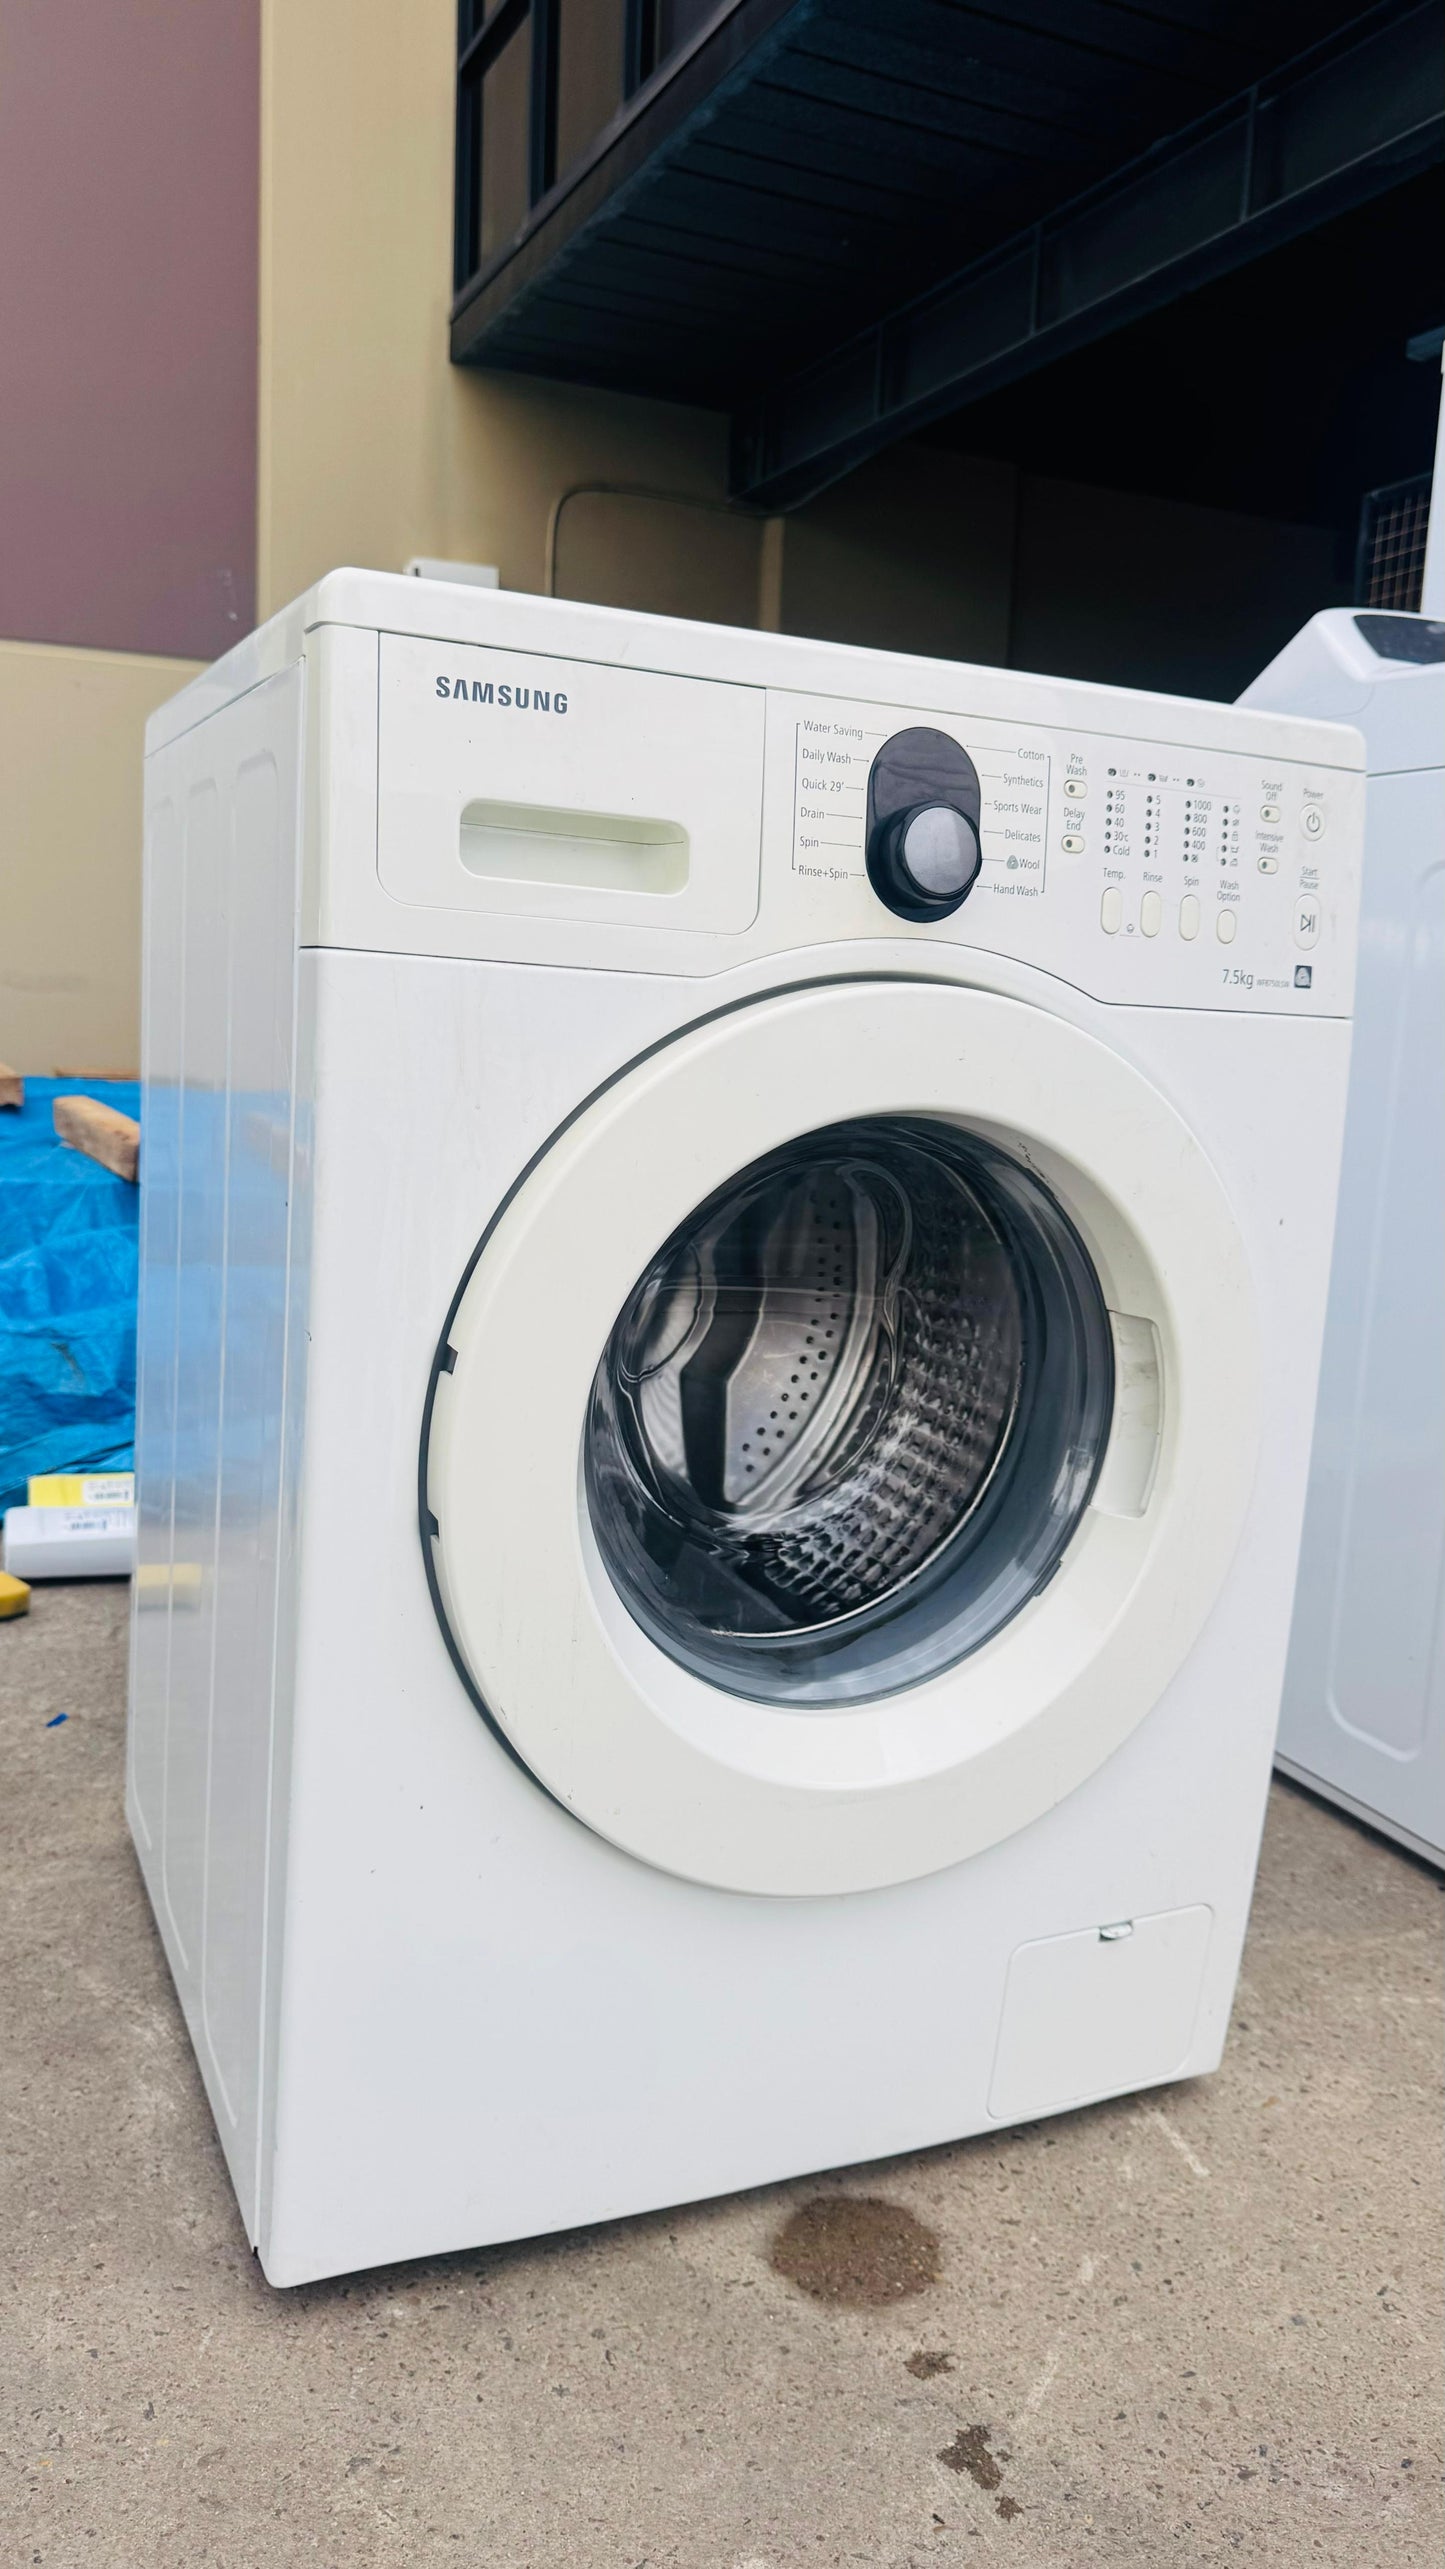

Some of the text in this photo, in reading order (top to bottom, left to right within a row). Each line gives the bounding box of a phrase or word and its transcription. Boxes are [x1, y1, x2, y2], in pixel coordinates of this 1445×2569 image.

[435, 676, 568, 714] SAMSUNG
[803, 720, 863, 740] Water Saving
[802, 748, 852, 764] Daily Wash
[1017, 748, 1045, 761] Cotton
[1070, 753, 1083, 764] Pre
[1066, 764, 1088, 776] Wash
[801, 778, 827, 791] Quick
[1003, 773, 1044, 788] Synthetics
[1261, 780, 1283, 792] Sound
[1115, 790, 1125, 800] 95
[1156, 795, 1161, 805] 5
[1265, 791, 1277, 801] Off
[1303, 788, 1324, 800] Power
[993, 800, 1042, 815] Sports Wear
[1114, 803, 1125, 814] 60
[1193, 799, 1212, 811] 1000
[800, 806, 825, 819] Drain
[1063, 807, 1085, 820] Delay
[1154, 808, 1160, 818] 4
[1193, 813, 1208, 824] 800
[1066, 820, 1081, 831] End
[1114, 817, 1124, 828] 40
[1155, 822, 1160, 832] 3
[1004, 829, 1041, 843] Delicates
[1192, 826, 1206, 838] 600
[1255, 830, 1285, 842] Intensive
[799, 835, 819, 849] Spin
[1153, 835, 1159, 846] 2
[1191, 840, 1206, 851] 400
[1112, 845, 1130, 856] Cold
[1260, 842, 1279, 853] Wash
[1019, 858, 1040, 870] Wool
[798, 865, 849, 880] Rinse+Spin
[1103, 867, 1126, 881] Temp.
[1143, 871, 1163, 883] Rinse
[1302, 865, 1318, 877] Start
[1183, 875, 1199, 888] Spin
[1219, 879, 1239, 890] Wash
[1299, 879, 1319, 890] Pause
[993, 883, 1039, 897] Hand Wash
[1217, 890, 1240, 902] Option
[1222, 968, 1254, 989] 7.5kg
